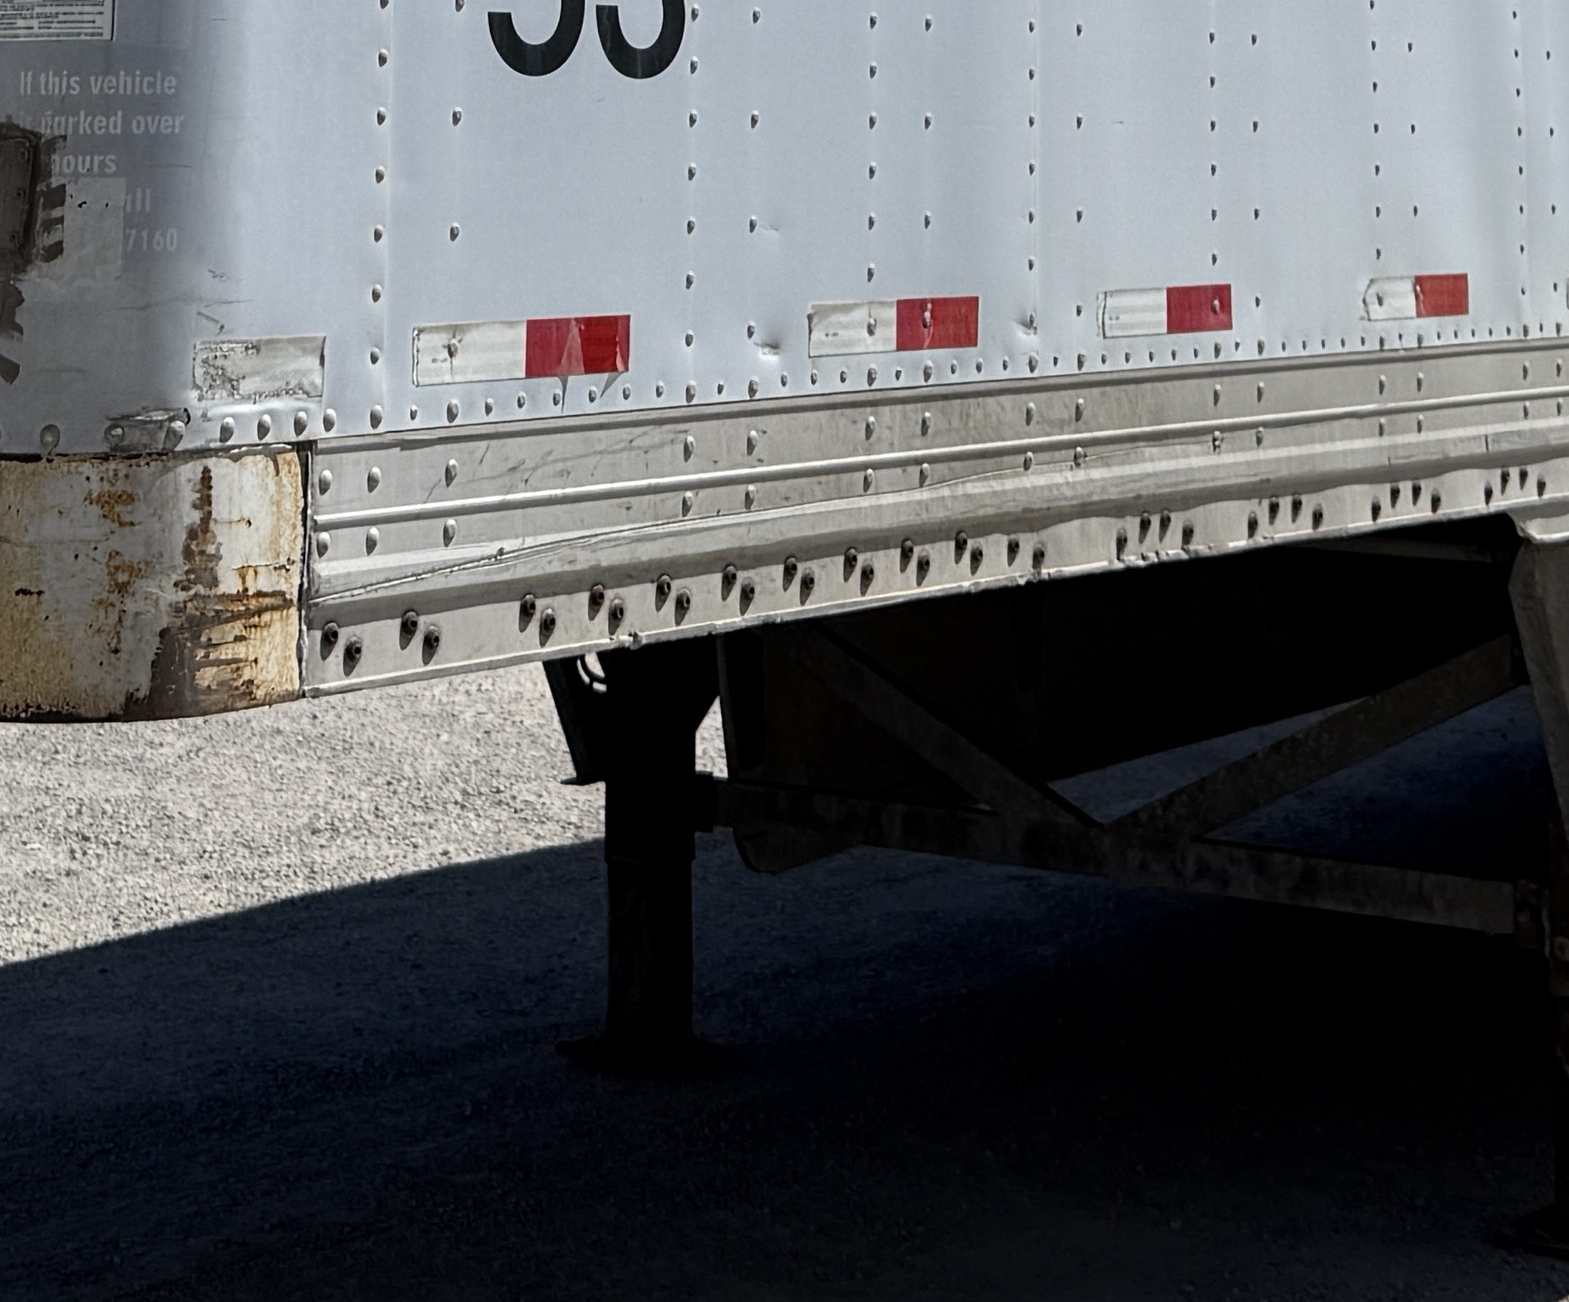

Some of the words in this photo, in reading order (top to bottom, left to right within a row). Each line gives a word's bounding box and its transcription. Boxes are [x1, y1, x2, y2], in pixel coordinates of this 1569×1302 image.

[20, 71, 33, 96] If
[39, 70, 82, 96] this
[89, 69, 177, 96] vehicle
[40, 109, 123, 136] parked
[132, 114, 185, 135] over
